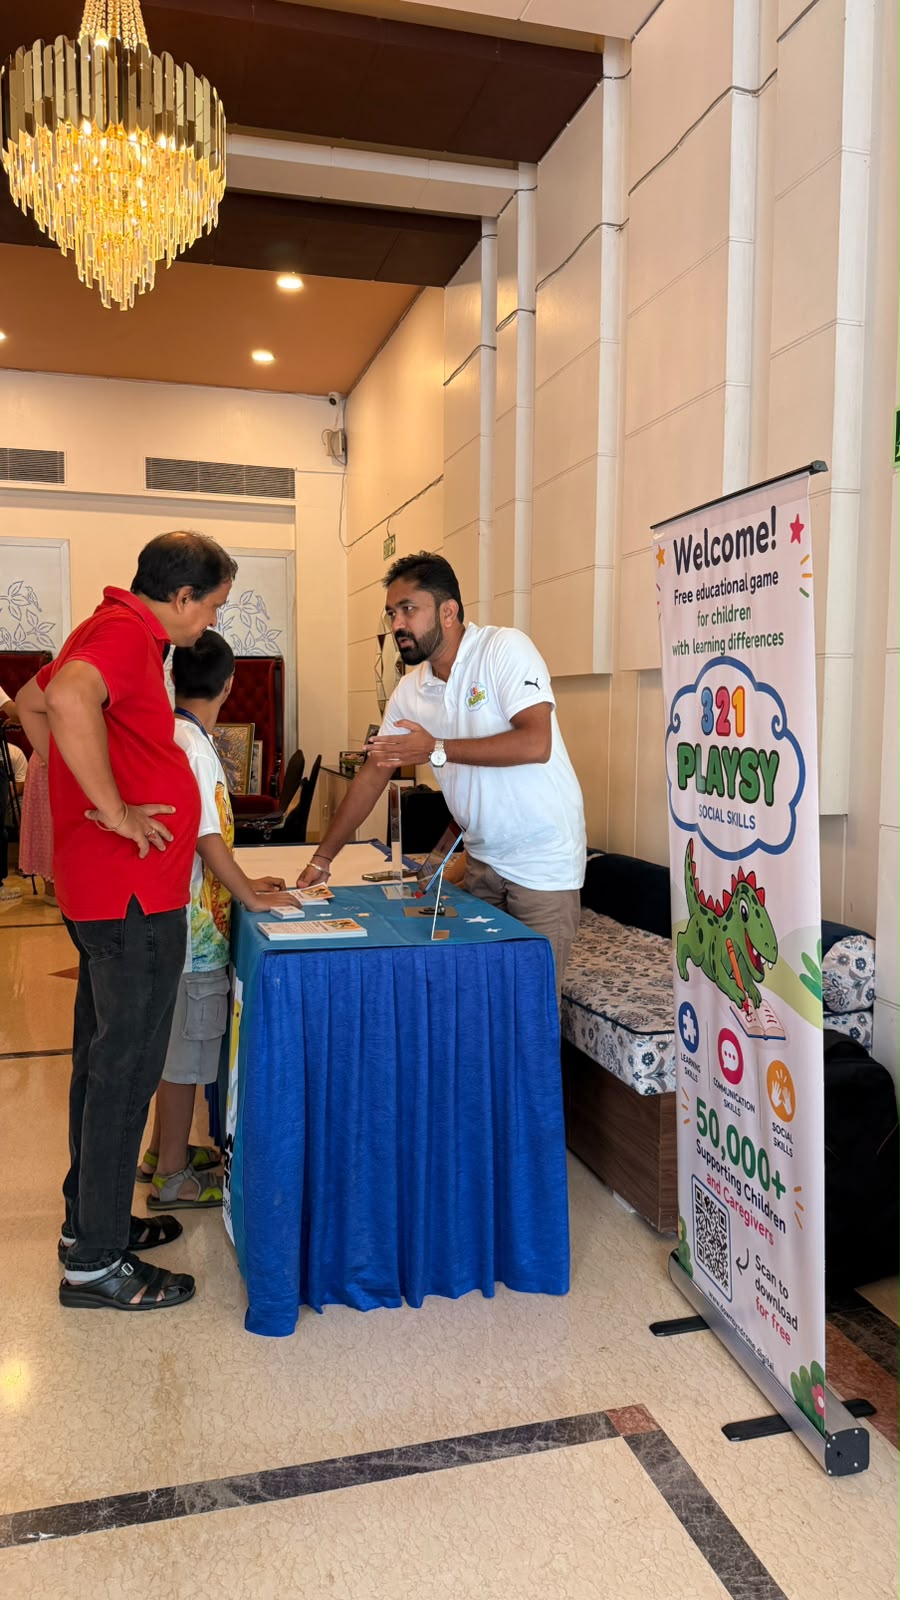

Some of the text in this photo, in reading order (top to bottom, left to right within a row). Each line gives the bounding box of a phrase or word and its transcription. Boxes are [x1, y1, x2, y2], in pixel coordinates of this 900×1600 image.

[673, 505, 777, 576] Welcome!
[674, 569, 779, 606] Free educational game
[697, 604, 751, 627] for children
[672, 631, 784, 657] with learning differences
[701, 685, 746, 738] 321
[677, 742, 779, 807] PLAYSY
[698, 804, 756, 831] SOCIAL SKILLS
[680, 1052, 701, 1074] LEARNING
[684, 1066, 699, 1083] SKILLS
[713, 1077, 756, 1114] COMMUNICATION
[723, 1100, 741, 1117] SKILLS
[696, 1097, 787, 1200] 50,000+
[772, 1121, 794, 1145] SOCIAL
[773, 1136, 793, 1158] SKILLS
[696, 1138, 787, 1234] Supporting Children
[706, 1172, 775, 1247] and Caregivers
[754, 1254, 790, 1300] Scan to
[755, 1277, 799, 1332] download
[756, 1296, 792, 1346] for free
